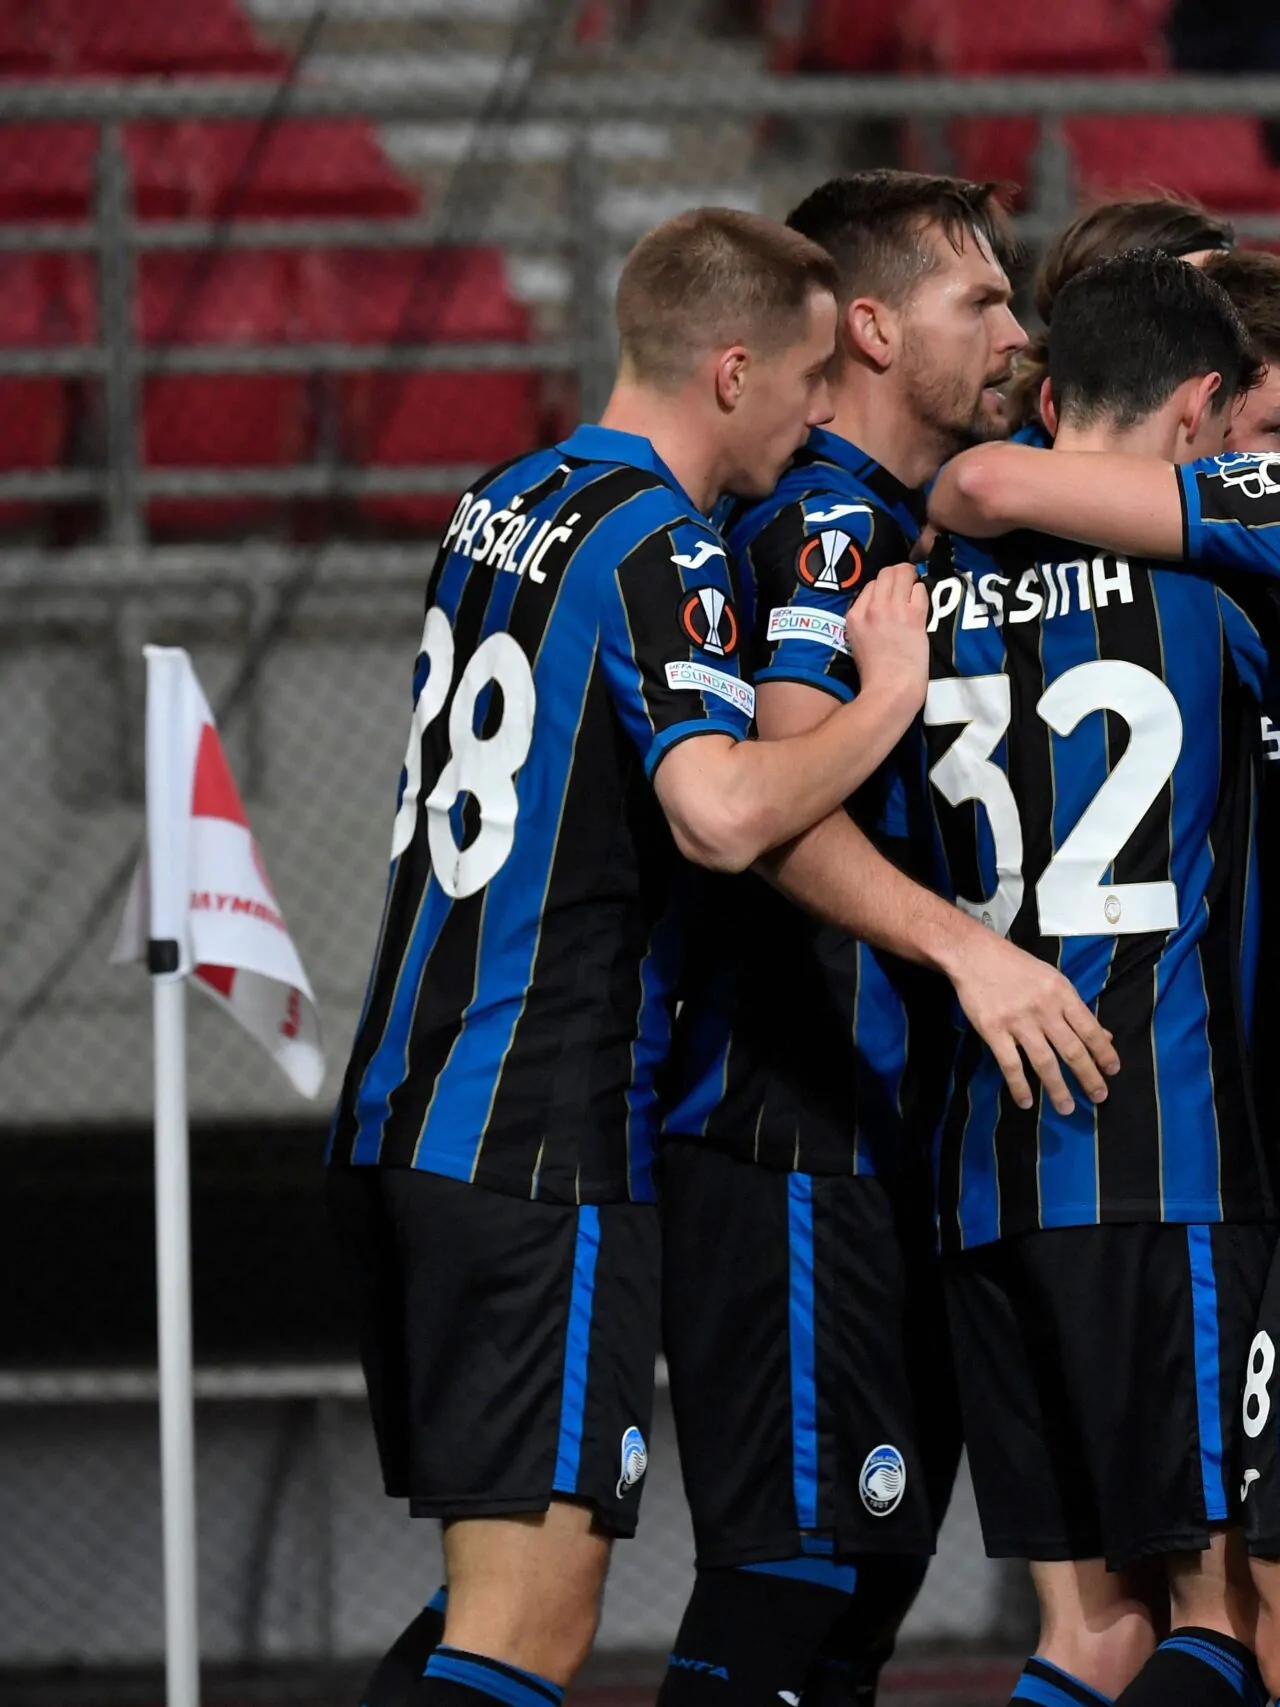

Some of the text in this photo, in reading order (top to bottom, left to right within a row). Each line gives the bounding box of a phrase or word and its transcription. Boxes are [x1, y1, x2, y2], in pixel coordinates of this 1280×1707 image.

[442, 492, 582, 585] PAŠALIĆ
[926, 552, 1134, 633] PESSINA
[670, 669, 754, 707] FOUNDATION
[923, 659, 1184, 937] 32
